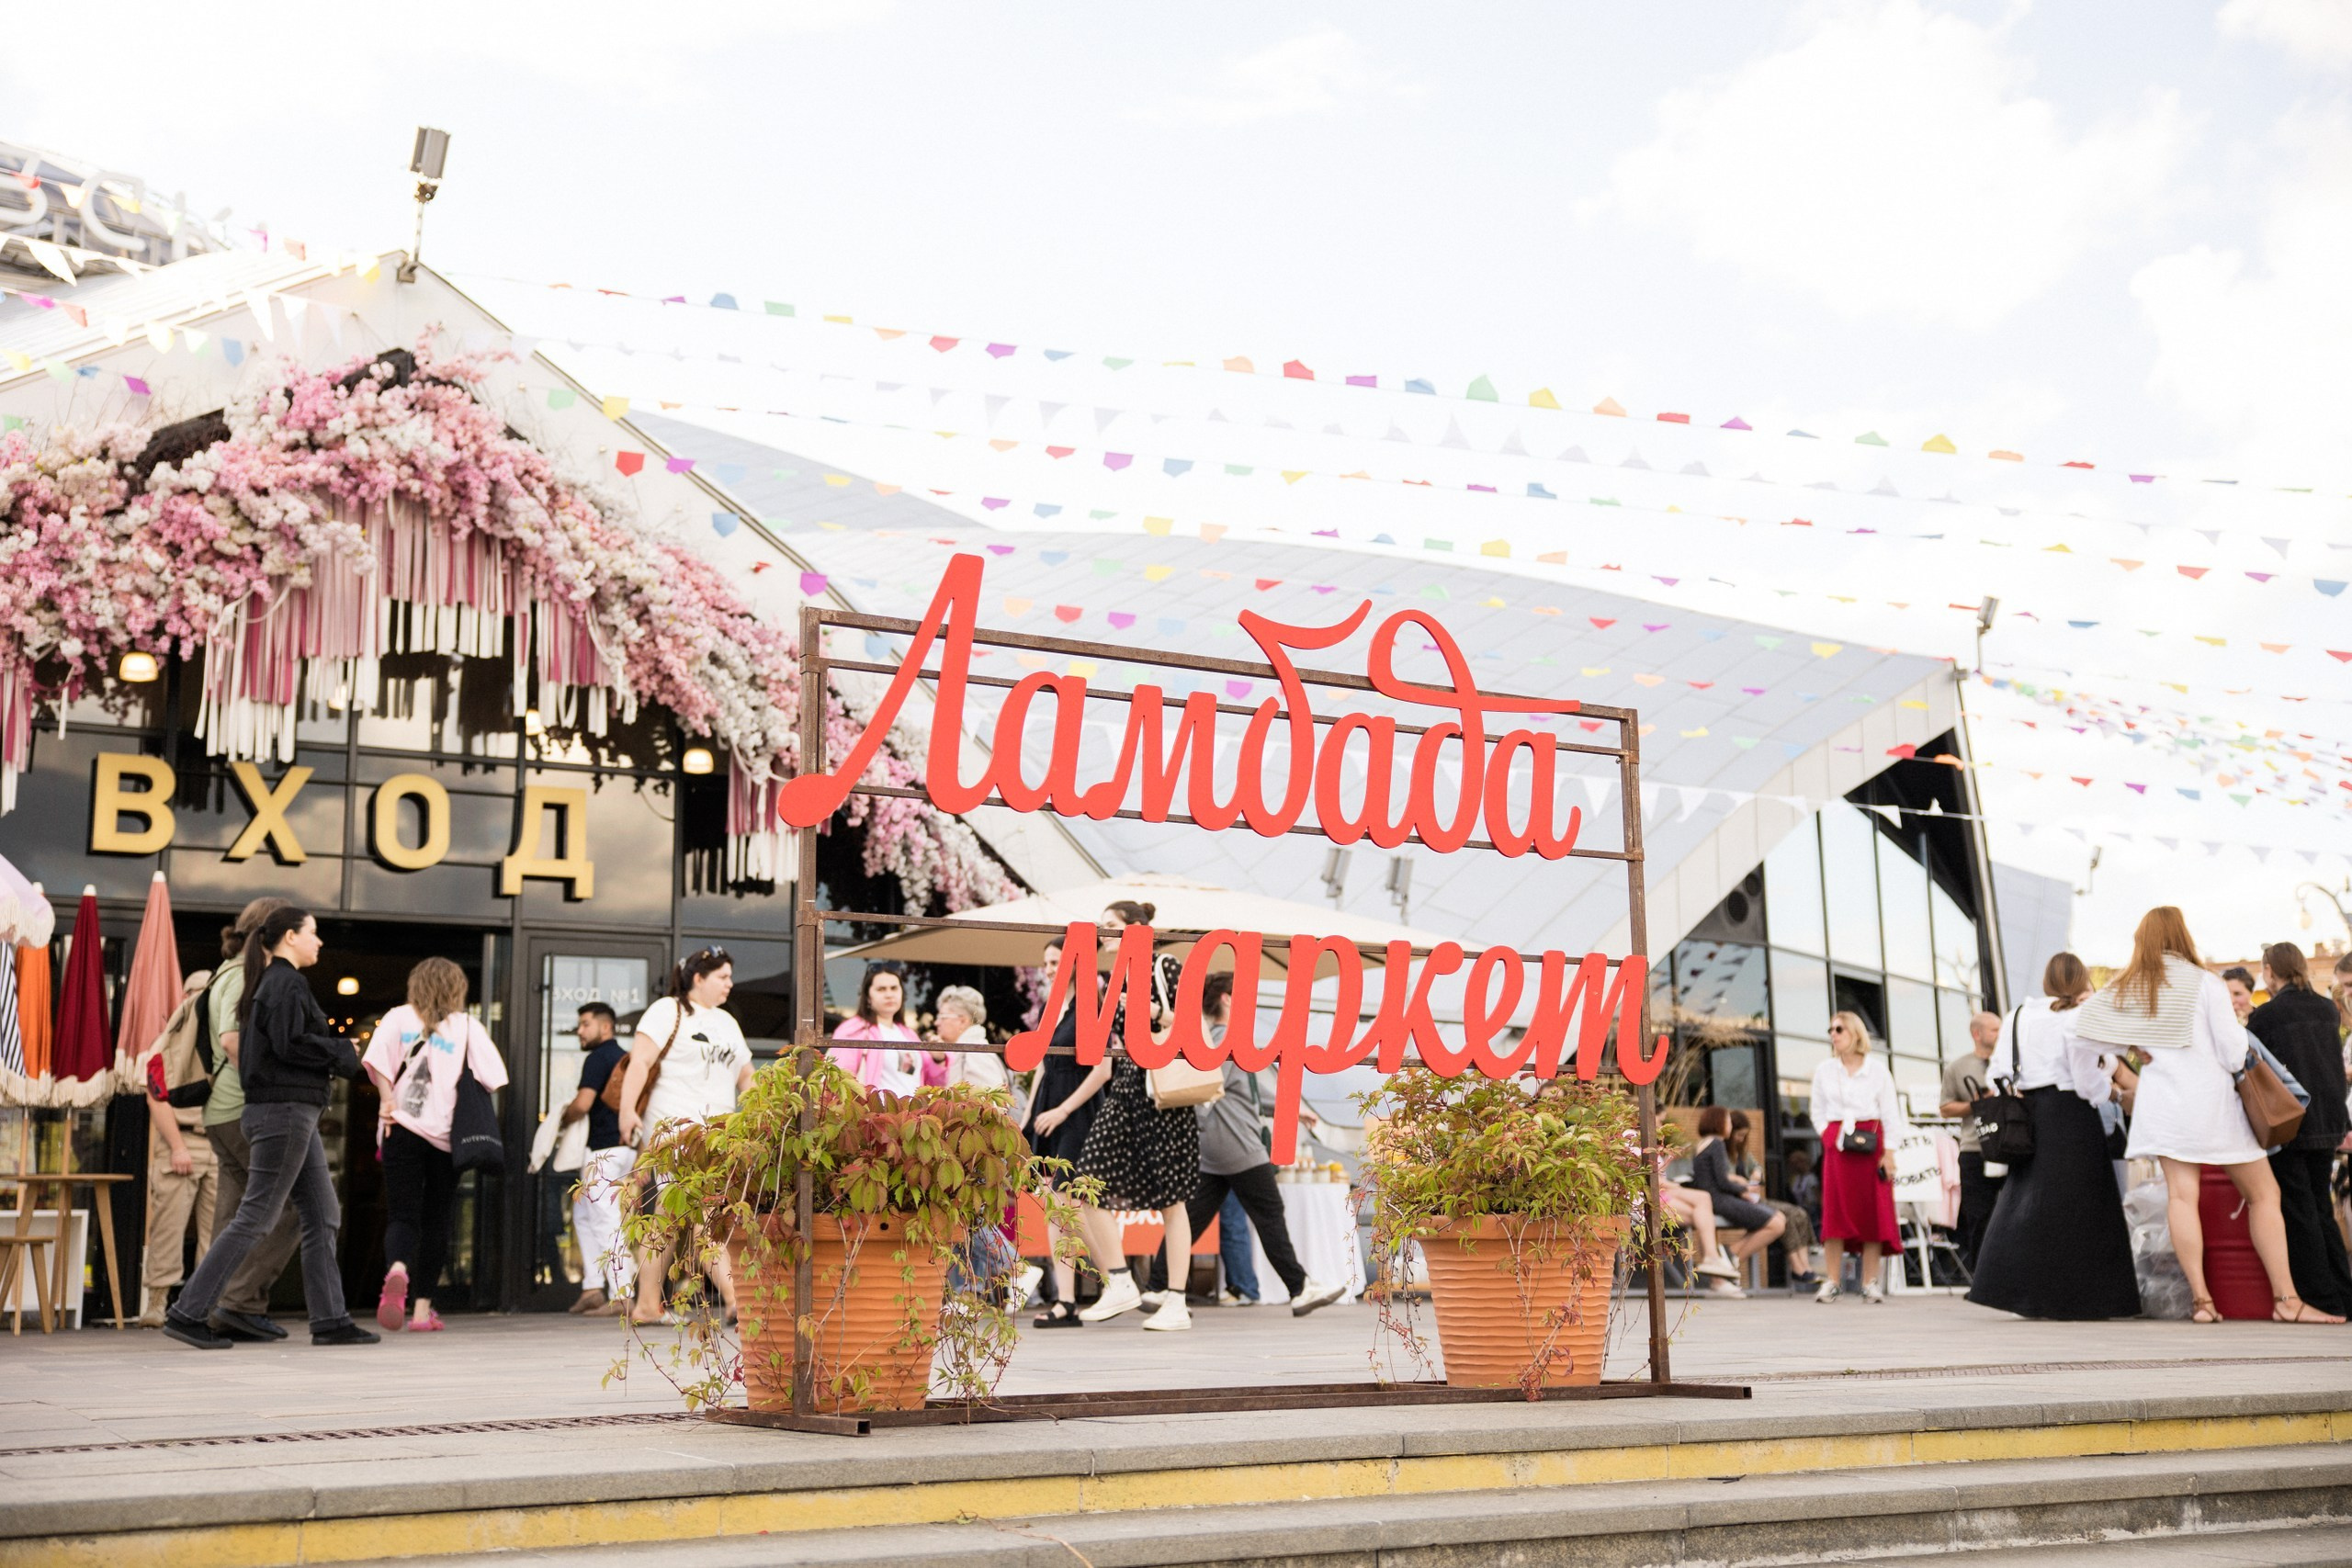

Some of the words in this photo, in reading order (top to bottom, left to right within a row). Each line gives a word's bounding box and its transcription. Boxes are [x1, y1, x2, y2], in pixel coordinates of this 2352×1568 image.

[90, 750, 595, 899] ВХОД
[777, 552, 1581, 860] Ламбада
[1005, 921, 1670, 1166] маркет
